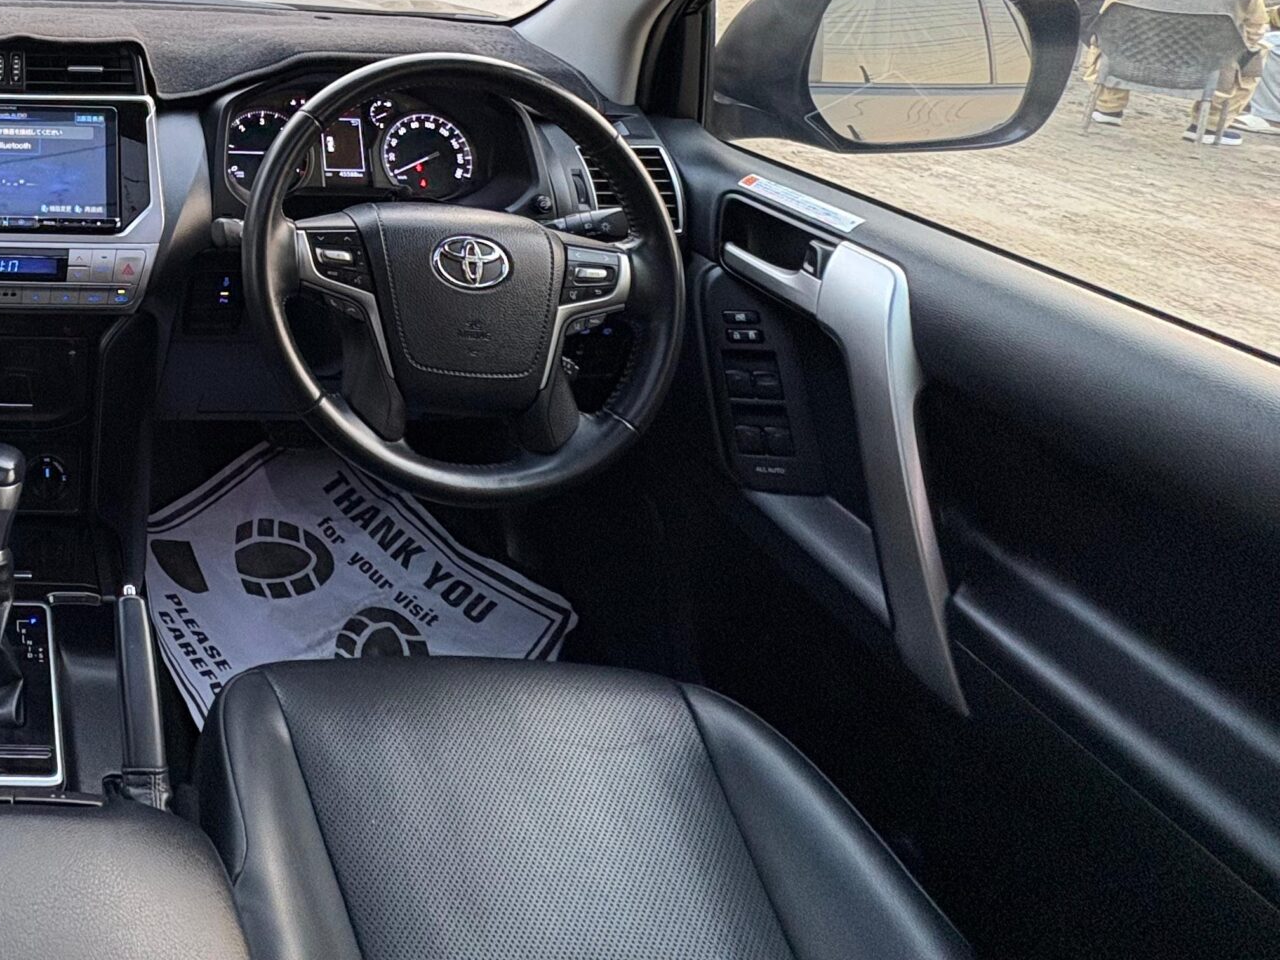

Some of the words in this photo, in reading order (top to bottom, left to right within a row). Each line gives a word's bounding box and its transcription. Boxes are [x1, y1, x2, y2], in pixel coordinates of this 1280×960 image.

[317, 516, 346, 545] for
[347, 551, 394, 595] your
[393, 588, 440, 628] visit
[322, 471, 426, 572] THANK
[422, 562, 499, 624] YOU
[164, 594, 232, 672] PLEASE
